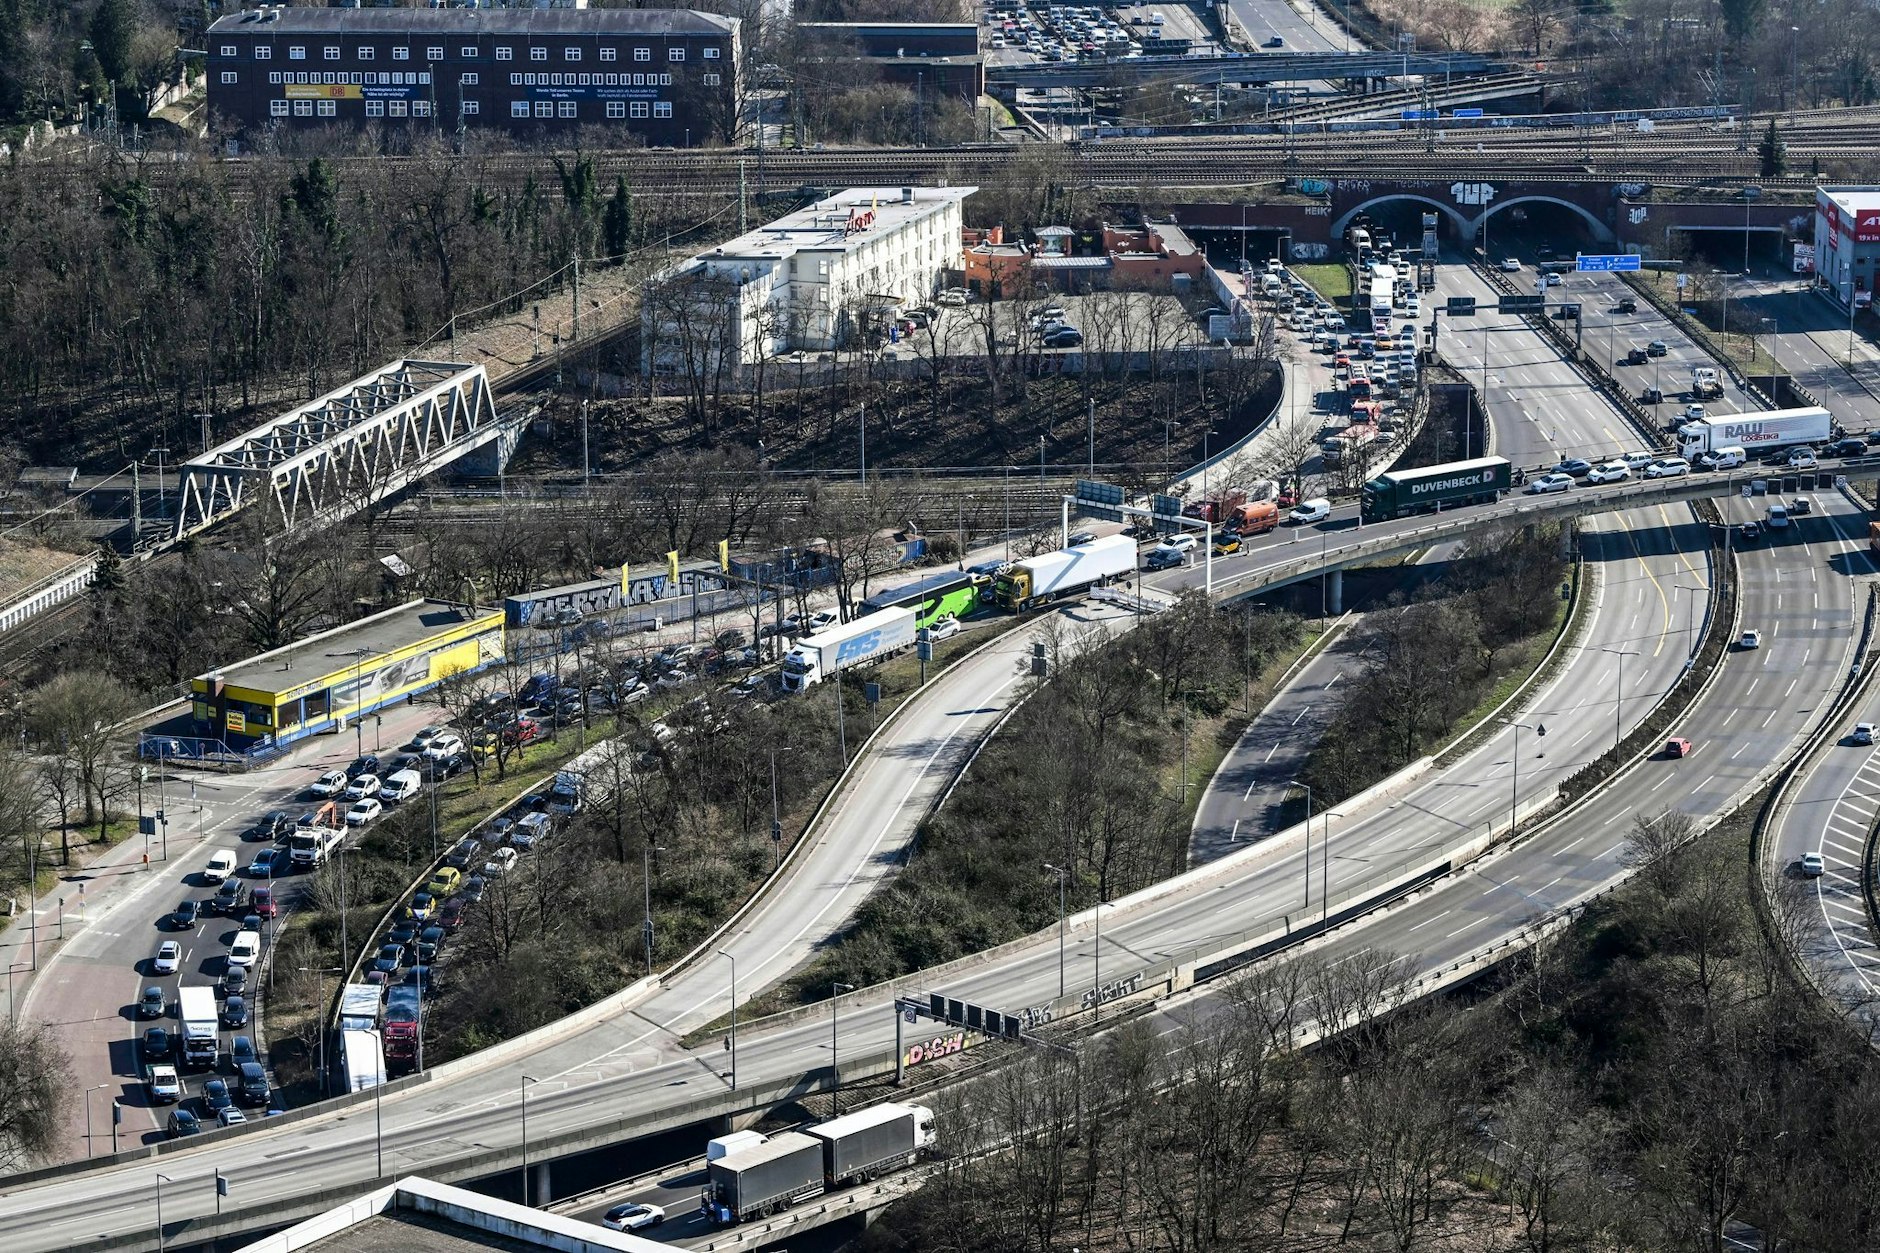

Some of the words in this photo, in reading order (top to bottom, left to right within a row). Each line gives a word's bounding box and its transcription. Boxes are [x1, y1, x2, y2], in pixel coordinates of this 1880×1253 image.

[331, 87, 344, 96] DB
[1725, 422, 1763, 439] RALU
[1412, 473, 1481, 495] DUVENBECK
